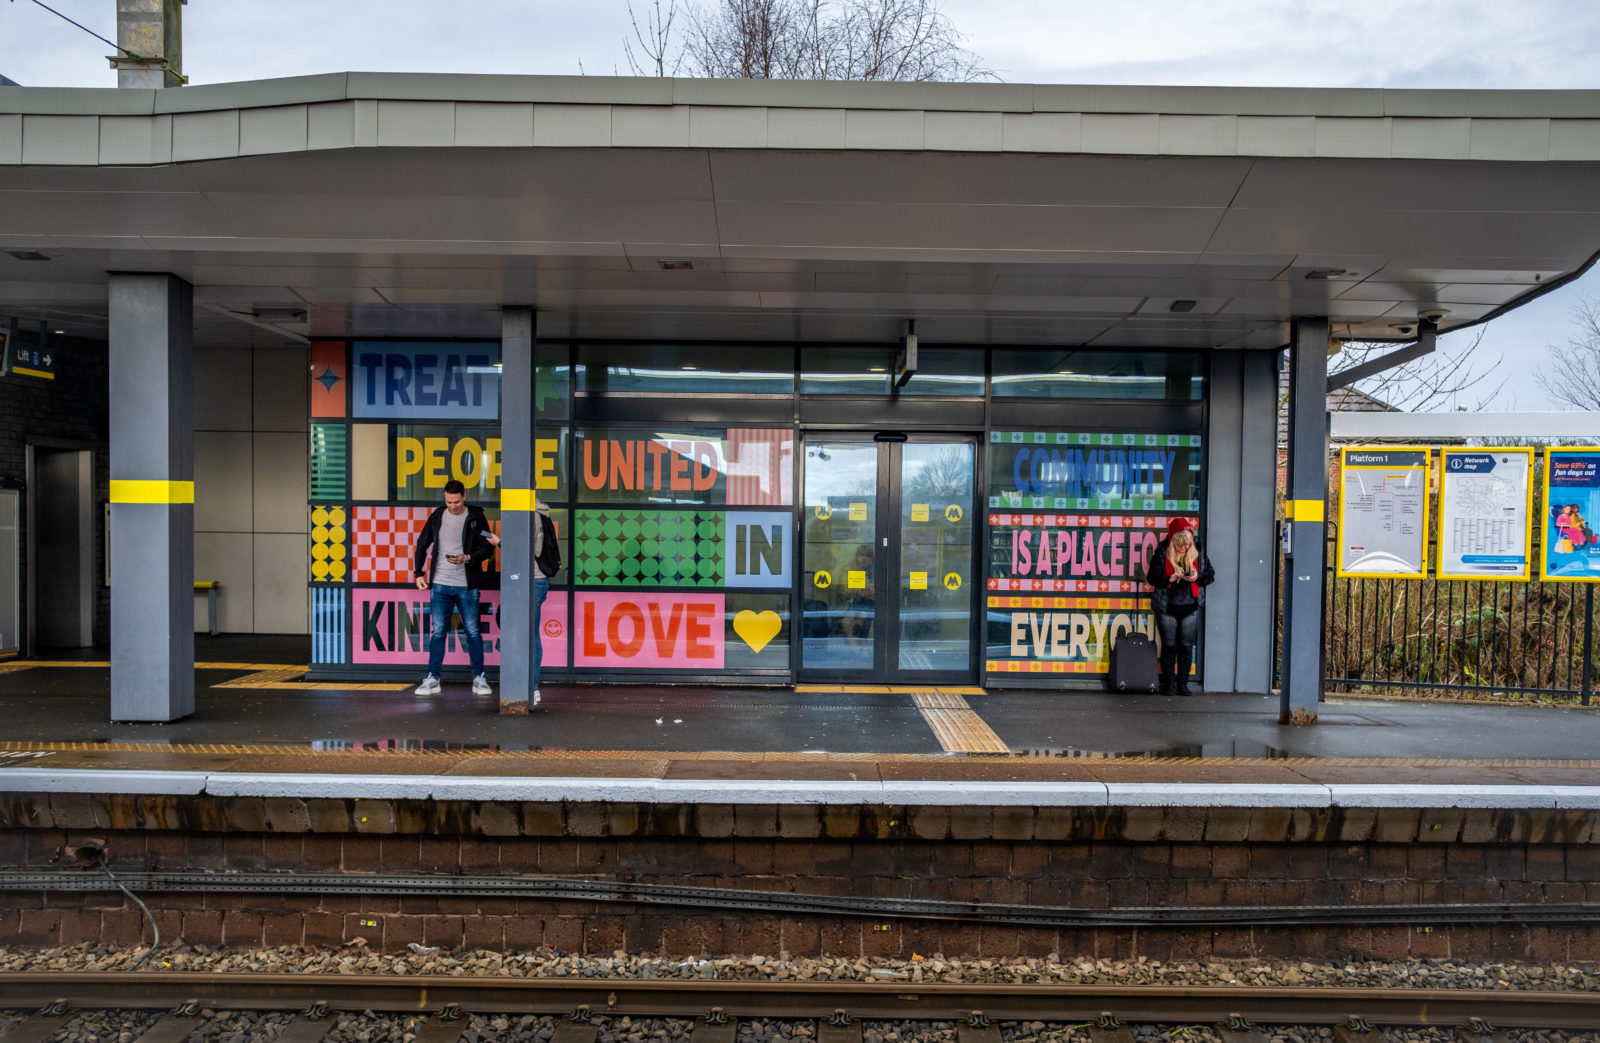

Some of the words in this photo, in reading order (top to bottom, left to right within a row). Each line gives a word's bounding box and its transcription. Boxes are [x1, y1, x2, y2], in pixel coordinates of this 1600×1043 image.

[18, 350, 30, 361] Lift
[359, 353, 490, 406] TREAT
[397, 437, 558, 489] PEOPE
[583, 439, 719, 491] UNITED
[1013, 447, 1176, 495] COMMUNITY
[1350, 455, 1383, 463] Platform
[1554, 469, 1566, 477] fun
[1567, 469, 1583, 477] days
[735, 524, 782, 576] IN
[1012, 529, 1032, 575] IS
[1036, 530, 1052, 575] A
[1056, 531, 1125, 576] PLACE
[1129, 531, 1168, 577] FO
[583, 602, 716, 659] LOVE
